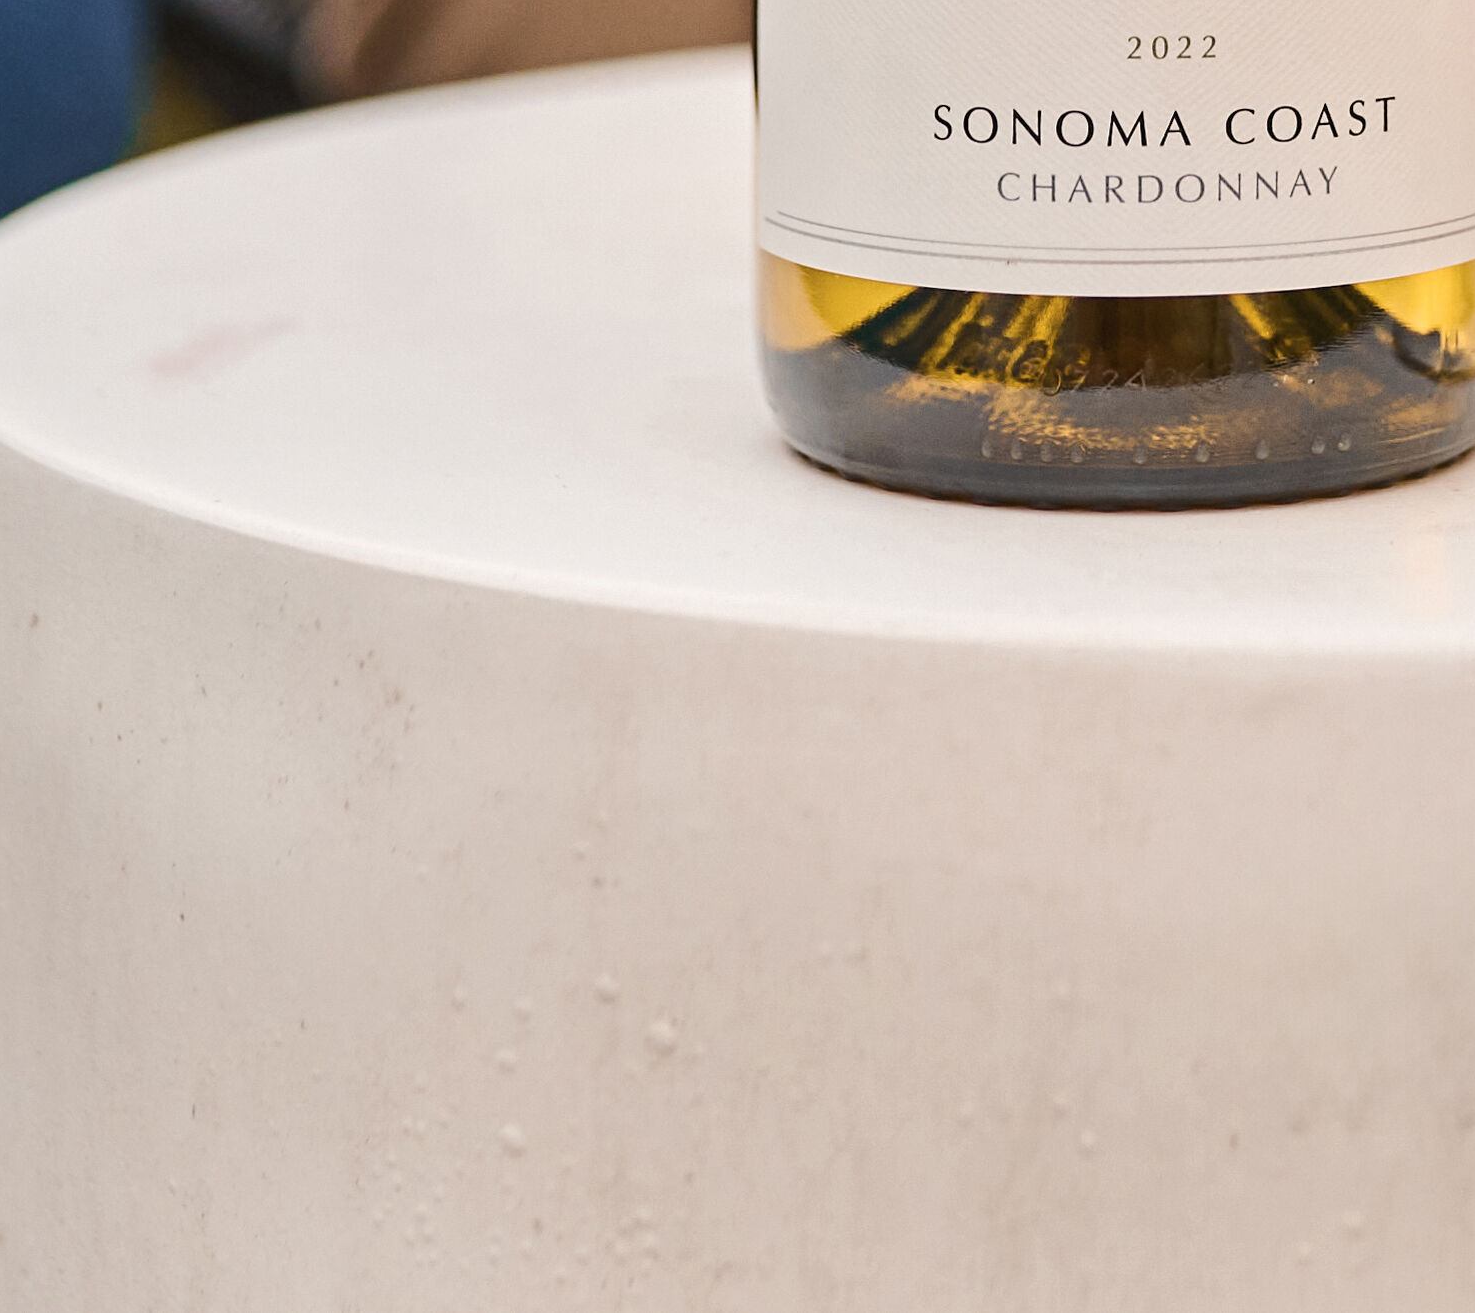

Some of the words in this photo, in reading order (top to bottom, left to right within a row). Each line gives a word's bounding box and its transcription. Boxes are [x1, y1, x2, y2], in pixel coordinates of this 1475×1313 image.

[1126, 34, 1217, 60] 2022
[933, 104, 1193, 148] SONOMA
[1225, 95, 1397, 146] COAST
[996, 165, 1339, 204] CHARDONNAY
